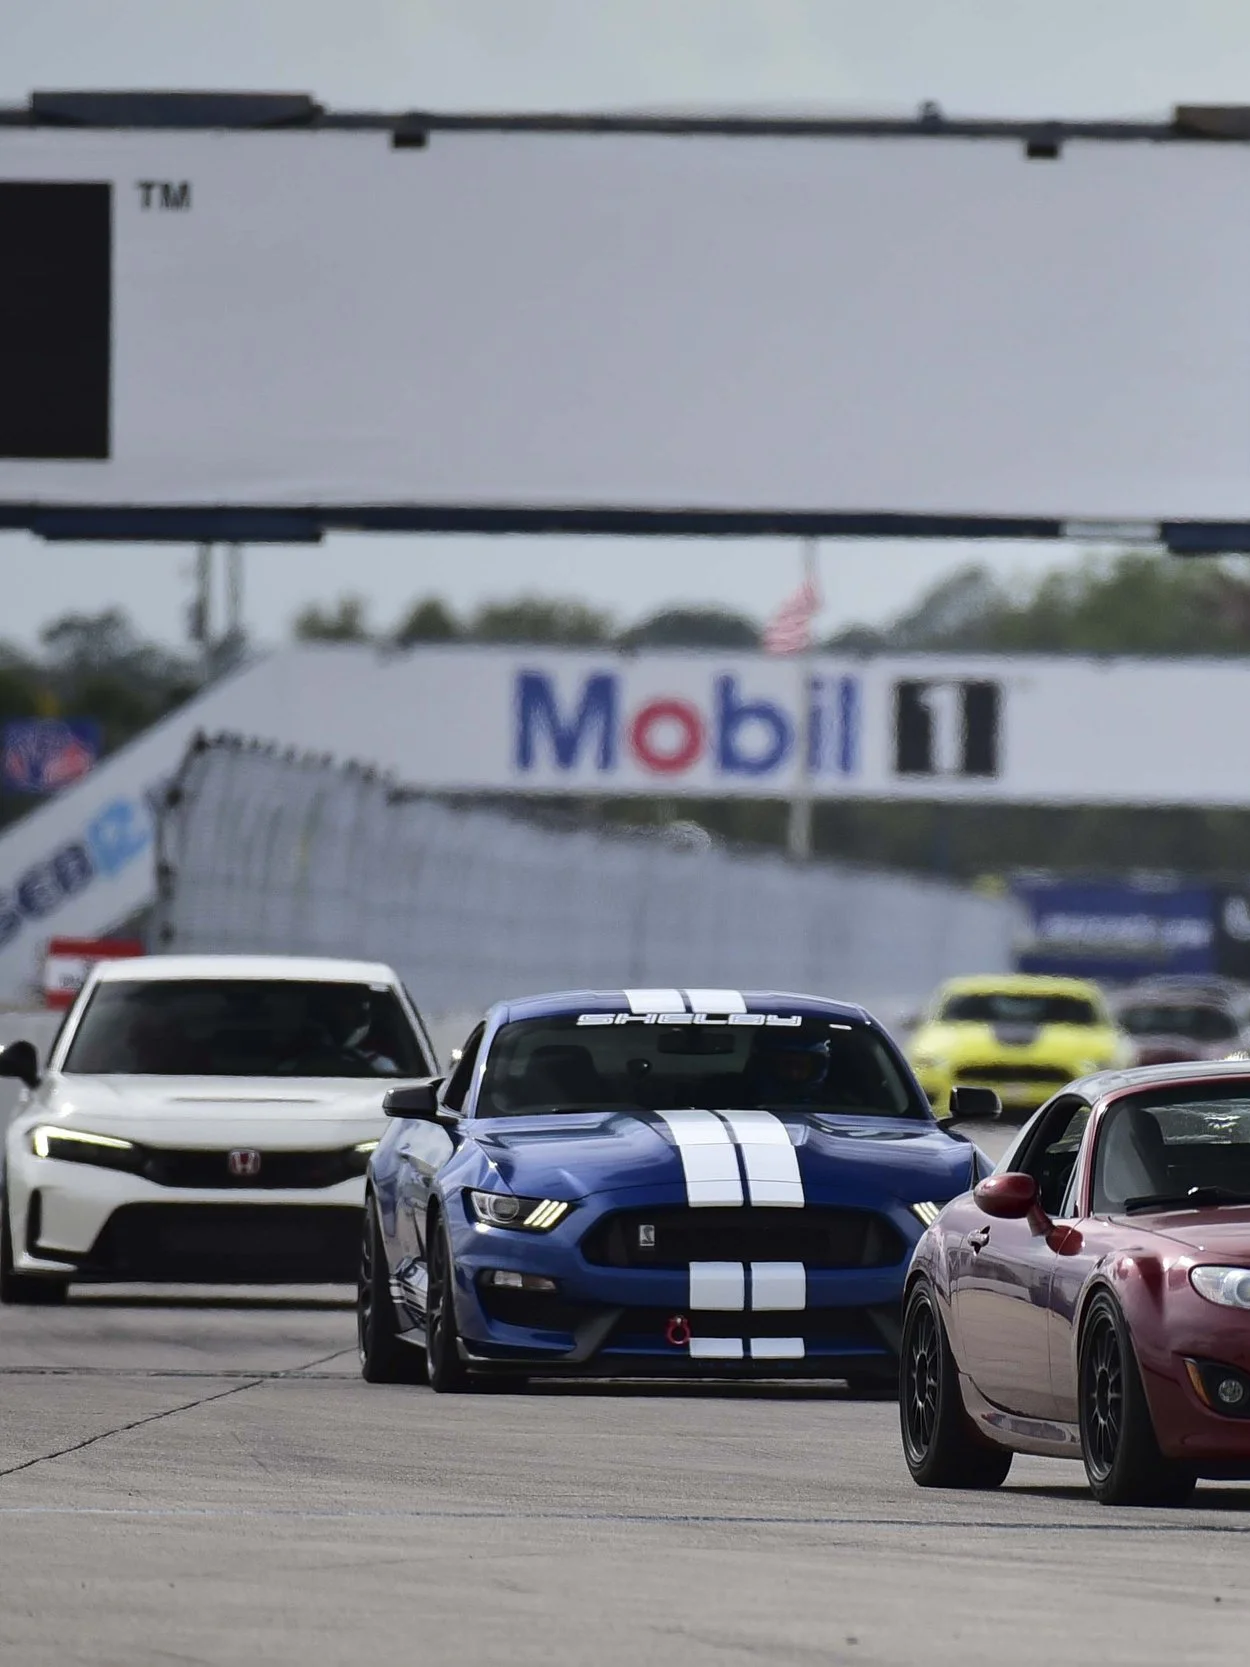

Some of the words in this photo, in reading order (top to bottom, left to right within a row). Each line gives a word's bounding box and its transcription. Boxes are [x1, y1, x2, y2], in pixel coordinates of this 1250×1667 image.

[136, 180, 192, 211] TM
[513, 668, 860, 777] Mobil
[575, 1012, 803, 1027] SHELBY
